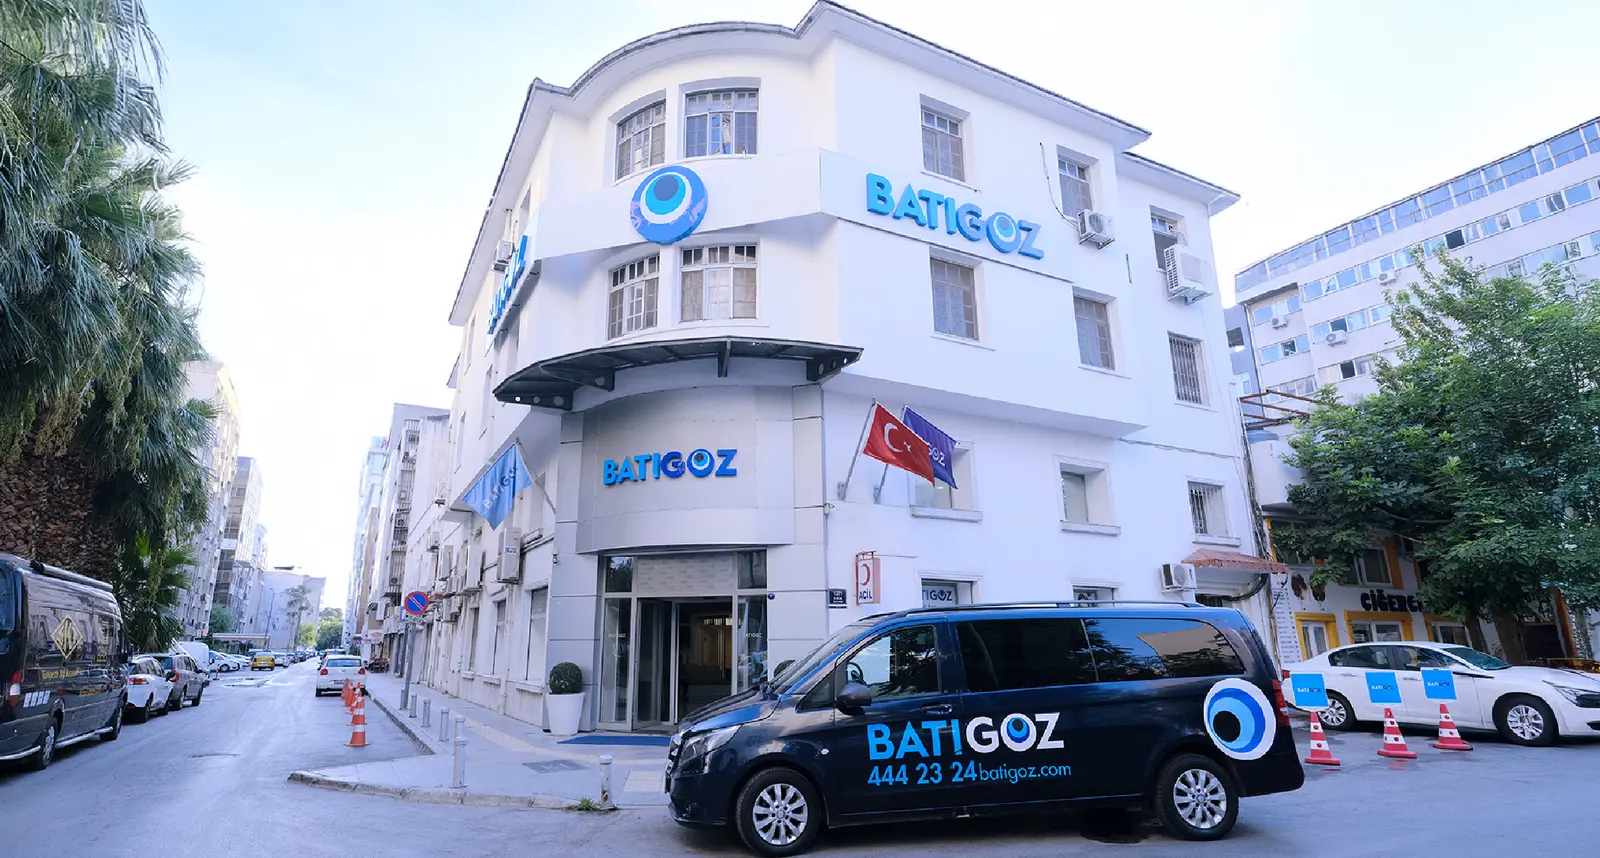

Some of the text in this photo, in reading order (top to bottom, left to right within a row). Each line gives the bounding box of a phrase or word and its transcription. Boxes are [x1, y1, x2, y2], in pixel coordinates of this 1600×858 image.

[866, 172, 1045, 260] BATIGOZ
[603, 448, 737, 485] BATIGOZ
[867, 712, 1065, 760] BATIGOZ
[867, 760, 1072, 786] 444 23 24 batigoz.com
